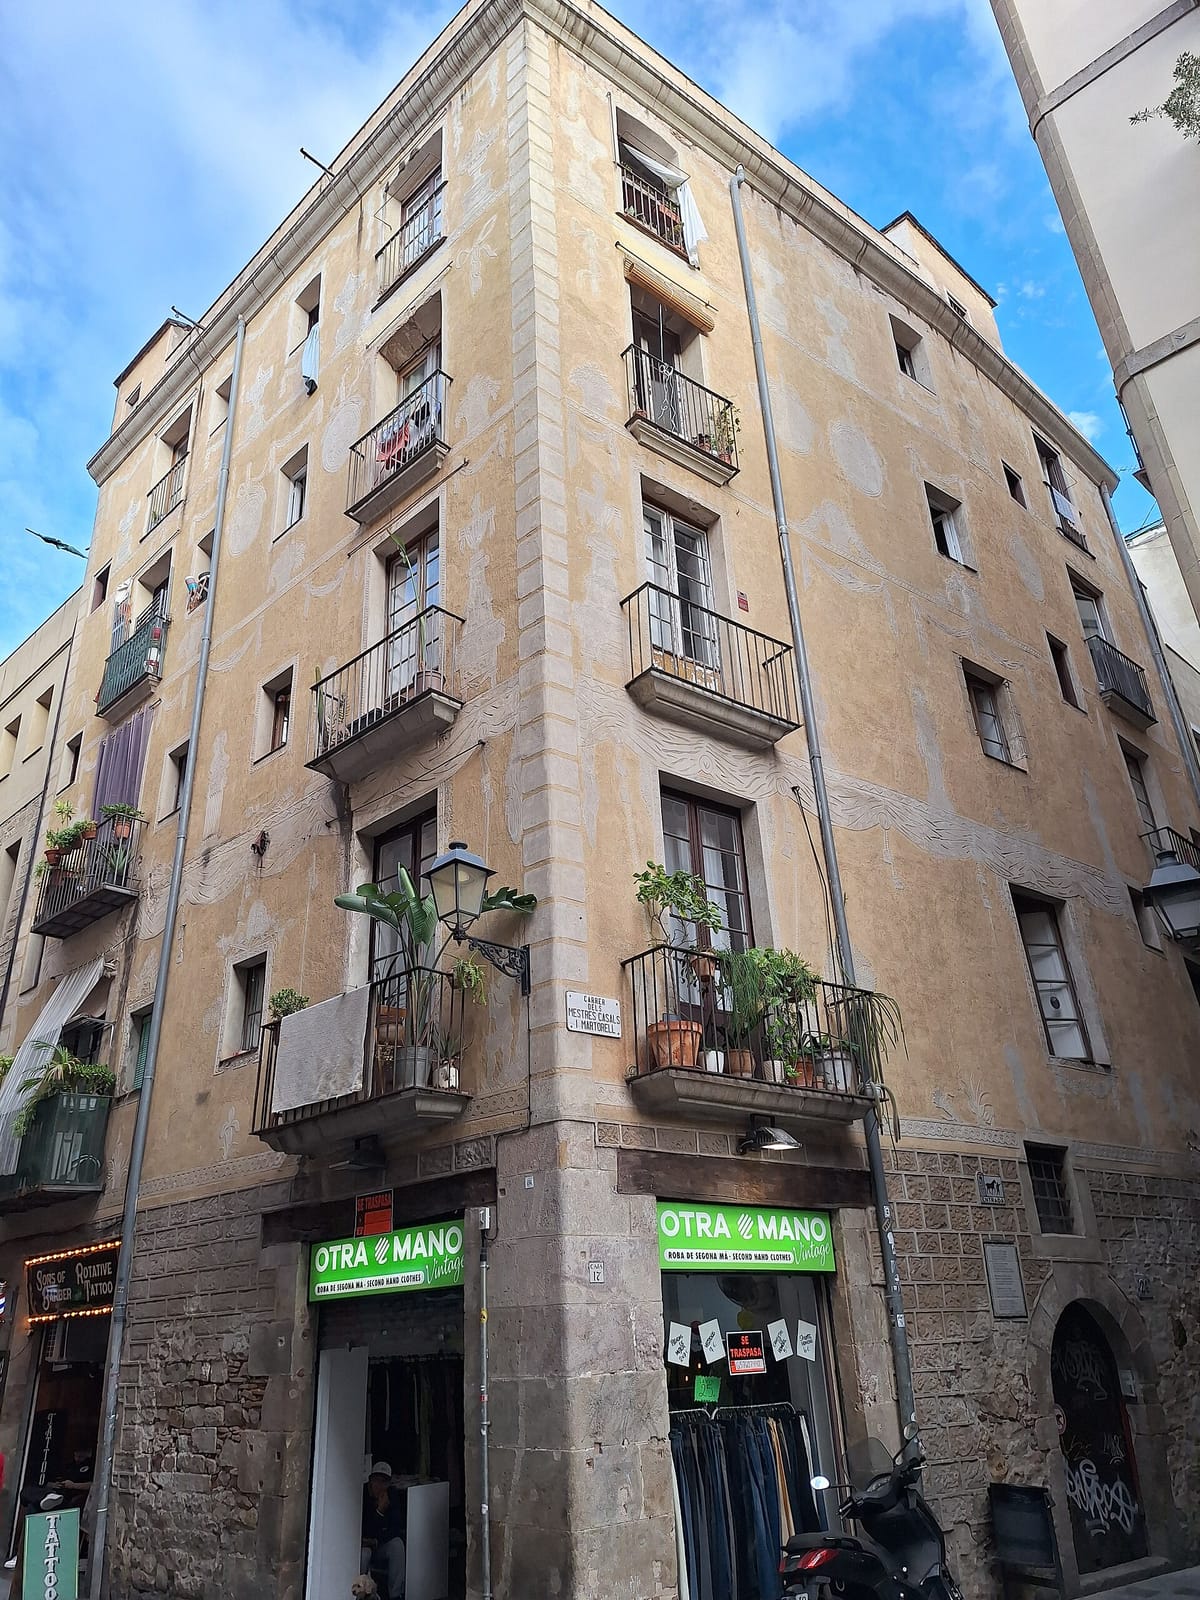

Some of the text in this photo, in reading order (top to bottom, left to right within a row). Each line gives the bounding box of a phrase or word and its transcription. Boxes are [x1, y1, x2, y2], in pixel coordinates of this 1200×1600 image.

[583, 995, 606, 1005] CARRER
[587, 1003, 602, 1012] DELS
[568, 1007, 621, 1025] MESTRES CASALS
[581, 1020, 616, 1034] MARTORELL
[660, 1209, 828, 1242] OTRA MANO
[314, 1225, 463, 1273] OTRA MANO
[668, 1251, 685, 1260] ROBA
[686, 1252, 694, 1260] DE
[694, 1252, 718, 1261] SEGONA
[732, 1253, 753, 1261] SECOND
[754, 1253, 769, 1261] HAND
[770, 1254, 792, 1262] CLOTHES
[793, 1240, 831, 1266] Vintage
[316, 1285, 329, 1294] ROBA
[337, 1282, 355, 1291] SEGONA
[366, 1278, 385, 1288] SECOND
[386, 1276, 399, 1285] HAND
[400, 1273, 421, 1284] CLOTHES
[740, 1335, 750, 1345] SE
[729, 1346, 763, 1359] TRASPASA
[44, 1514, 61, 1600] TATTOO
